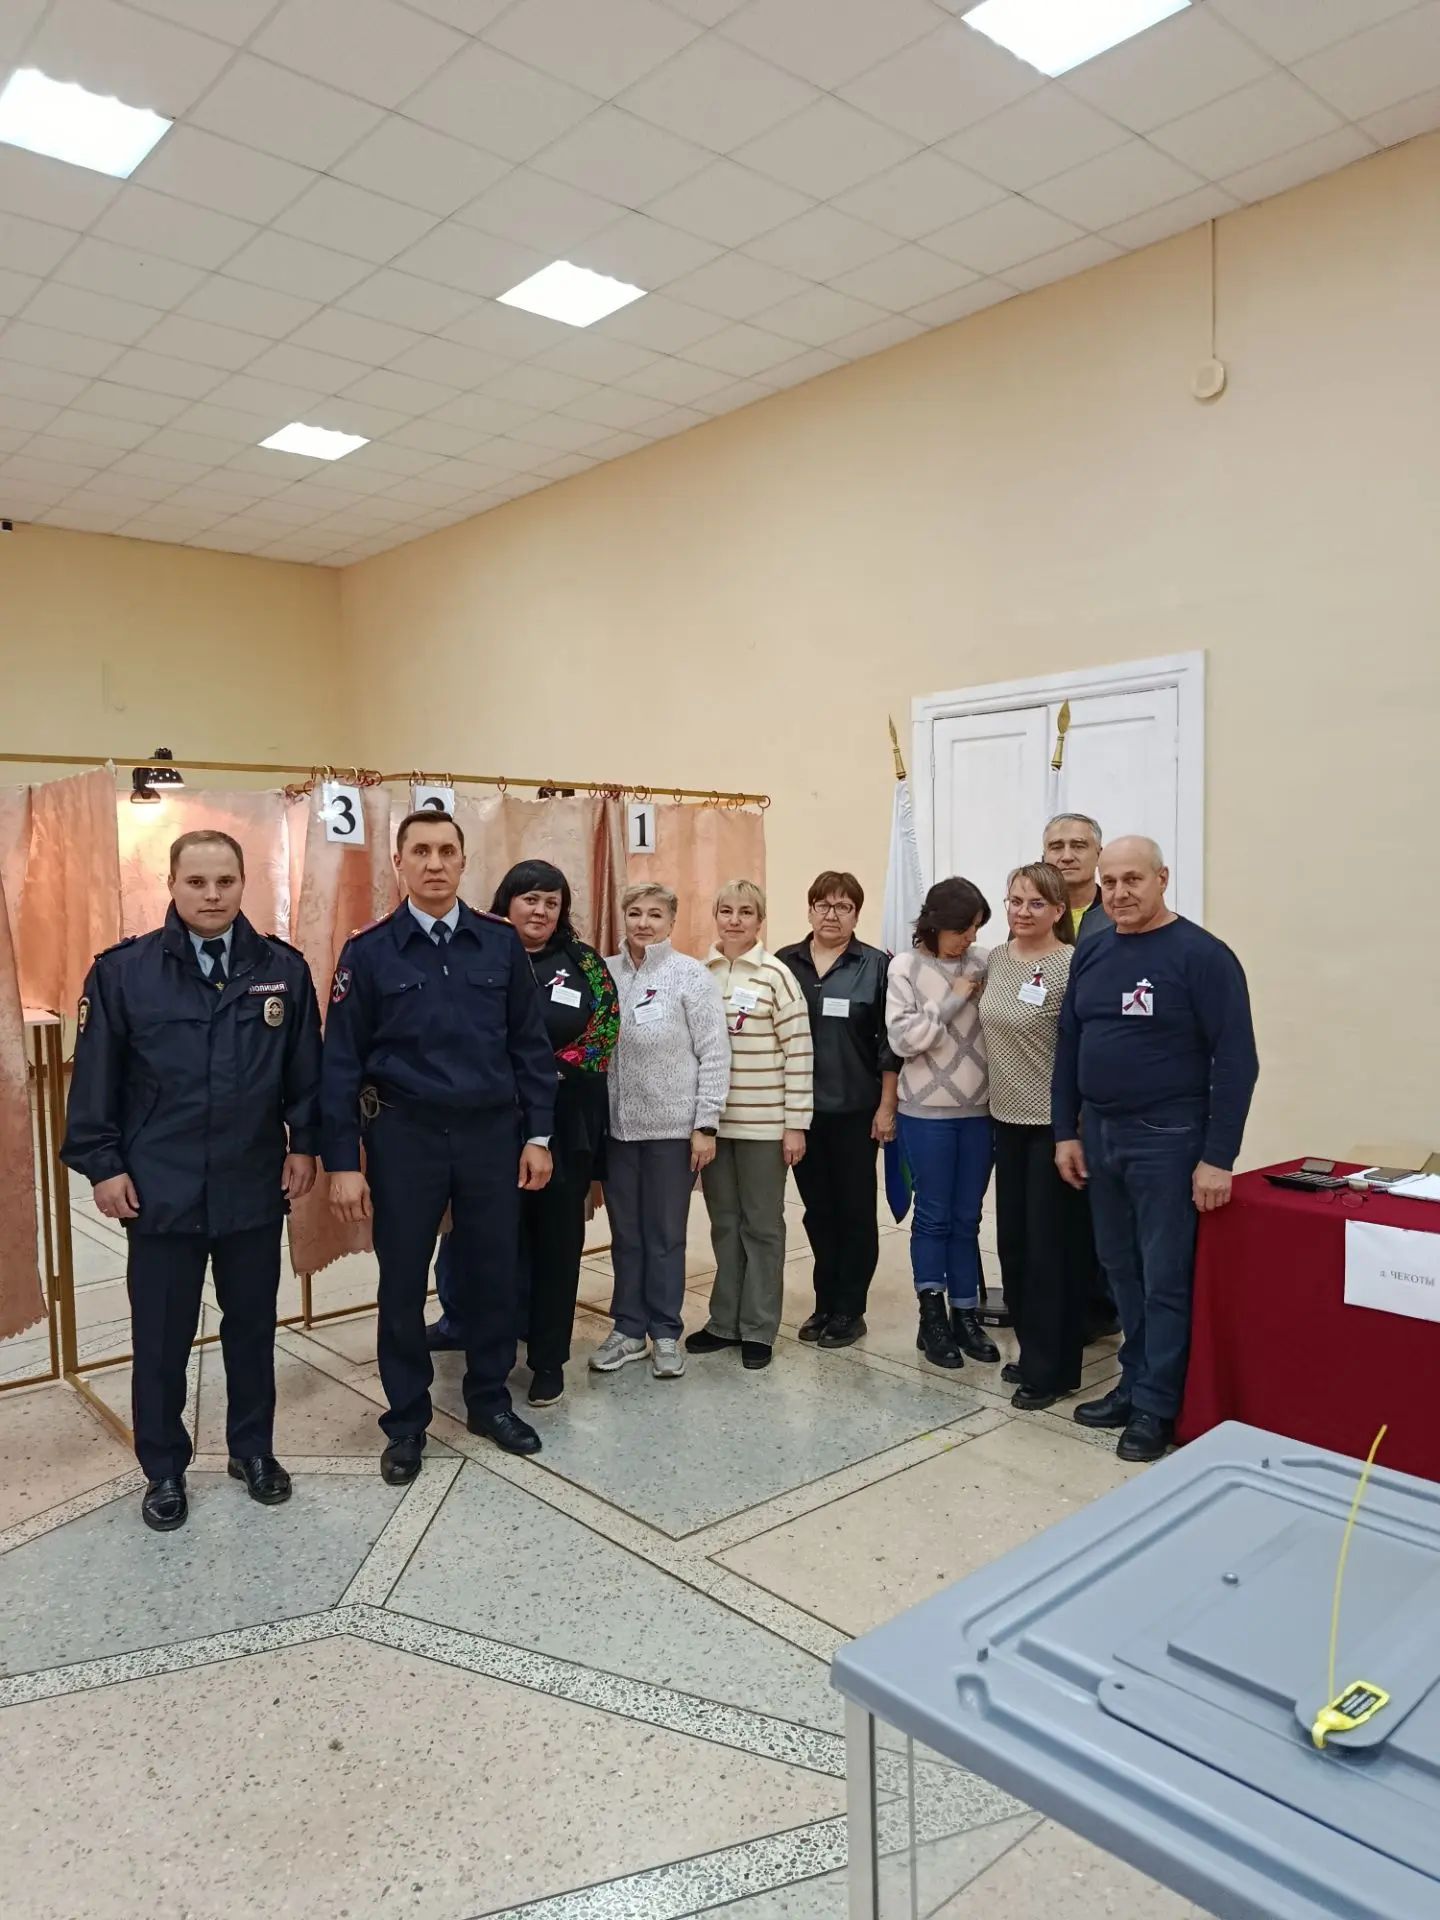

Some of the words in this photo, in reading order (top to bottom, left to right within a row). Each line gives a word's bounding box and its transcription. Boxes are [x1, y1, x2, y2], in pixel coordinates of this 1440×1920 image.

[331, 795, 356, 835] 3
[634, 812, 649, 847] 1
[250, 983, 286, 993] ПОЛИЦИЯ
